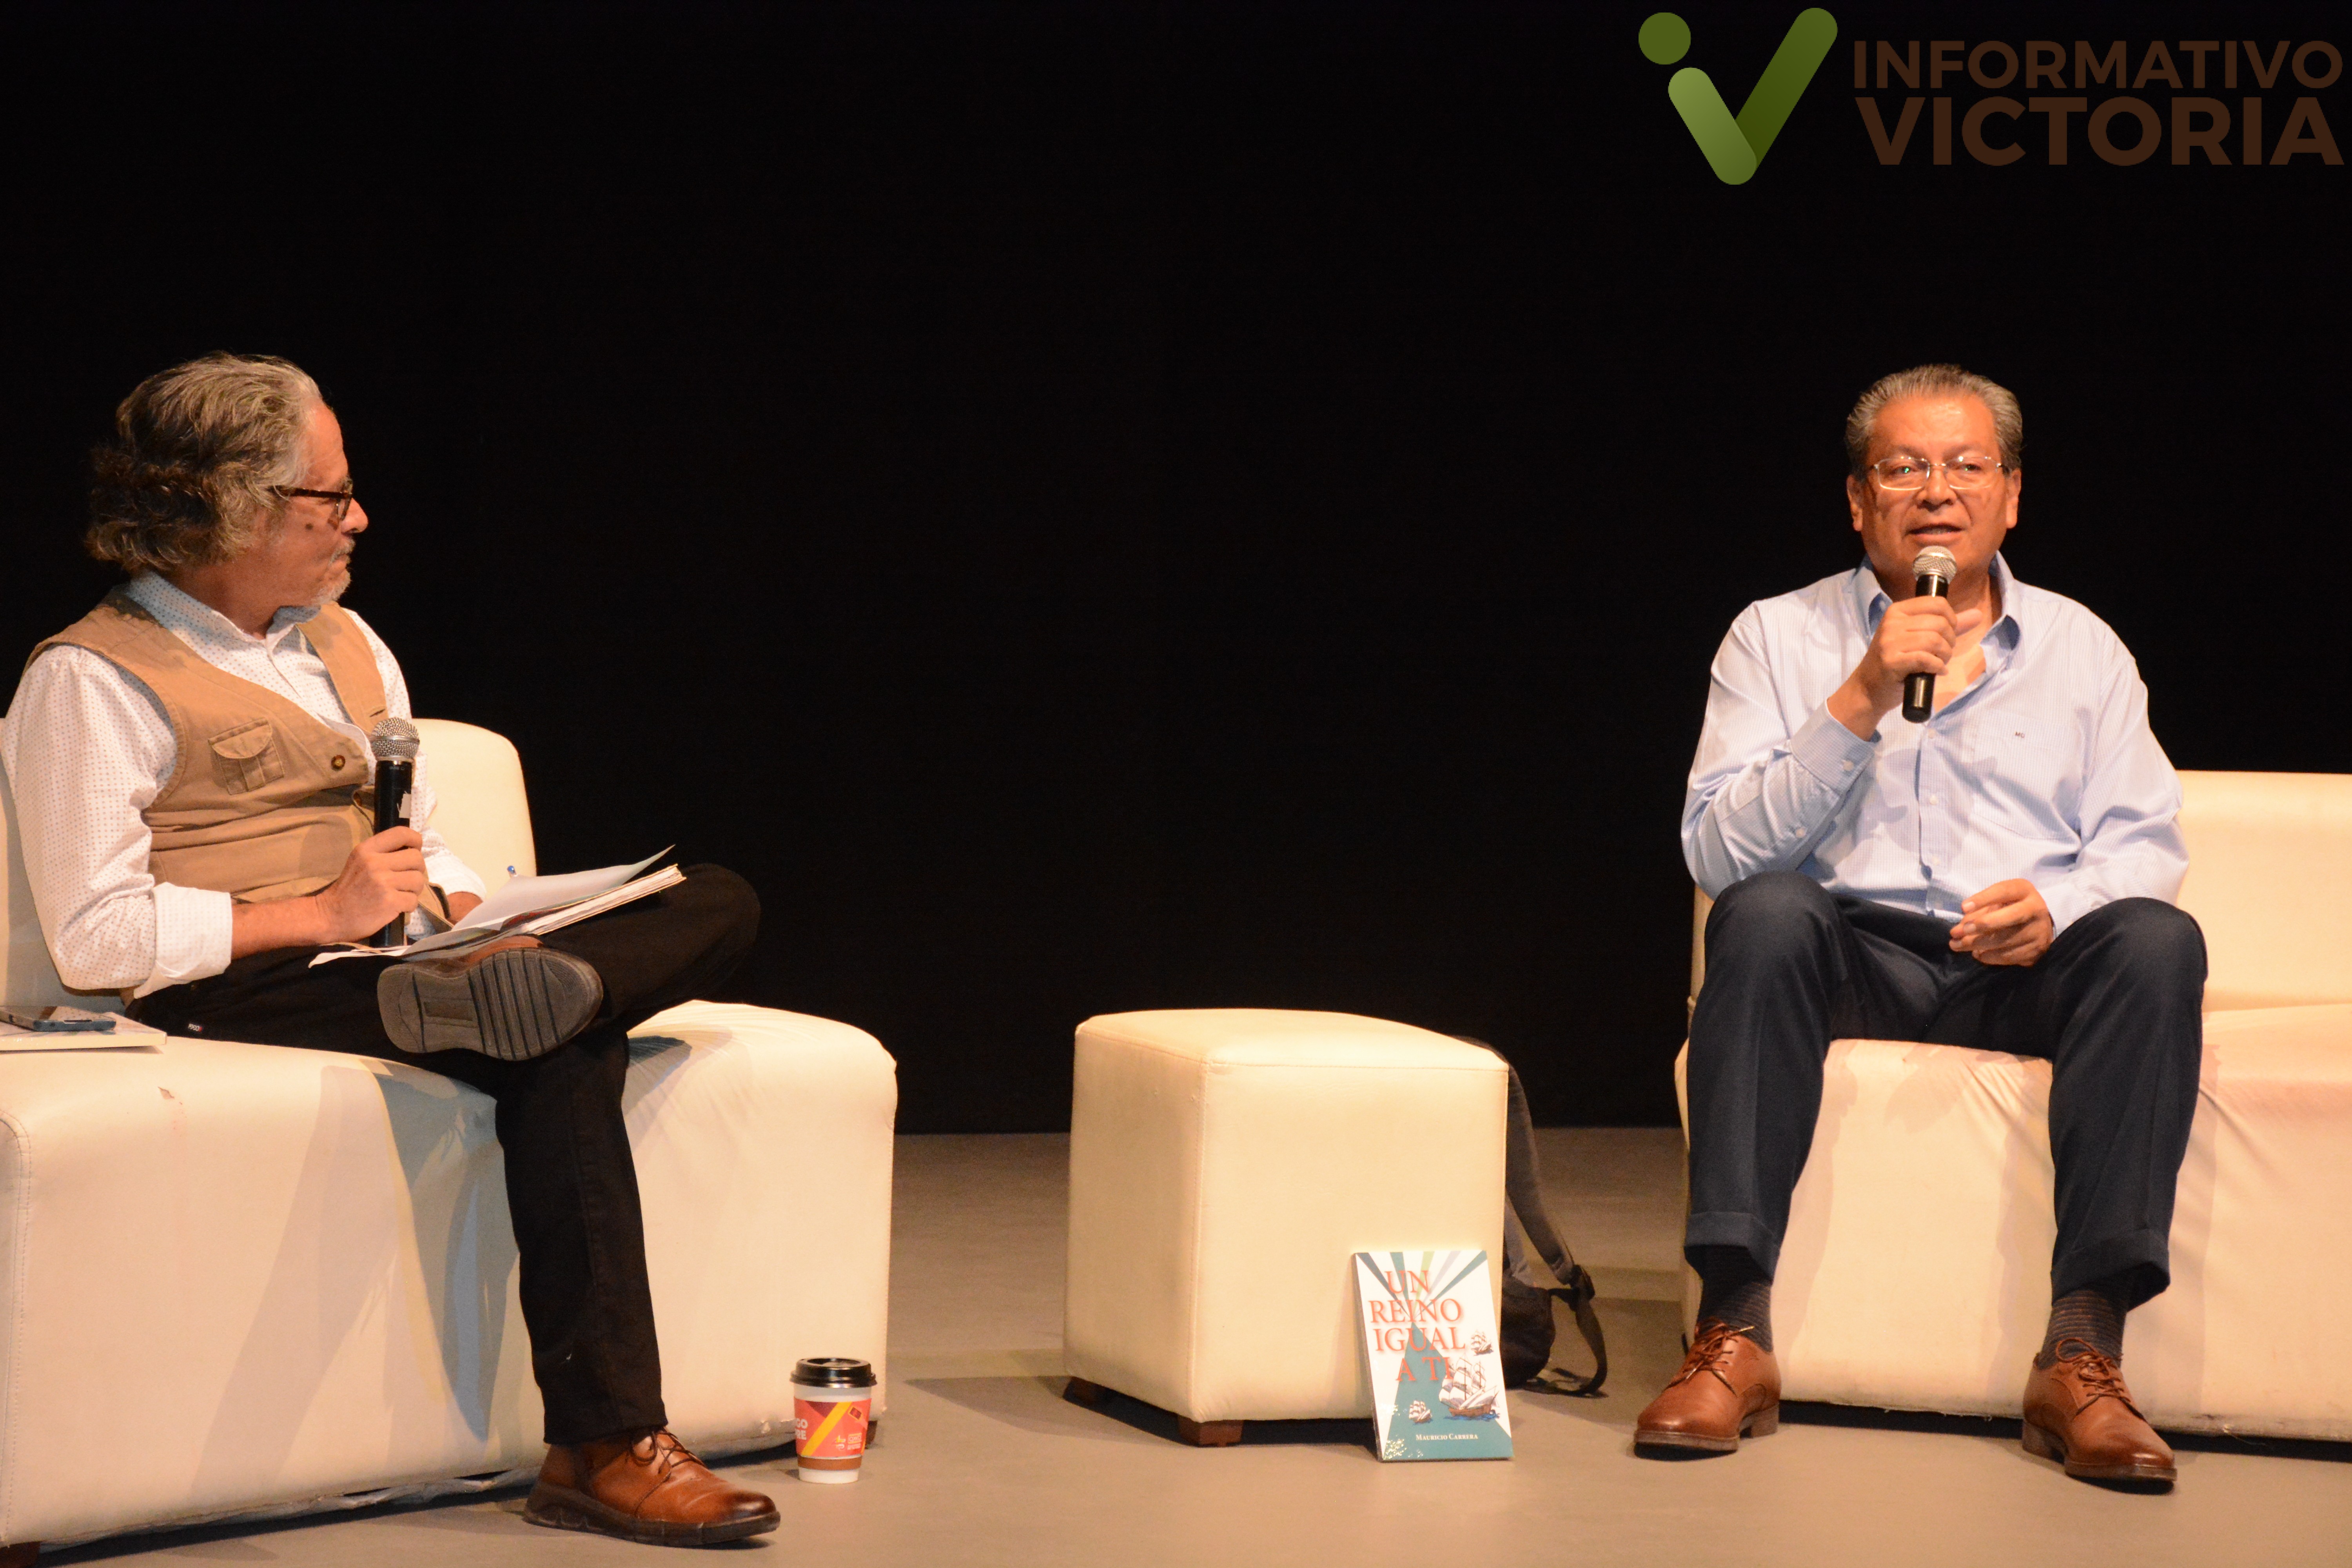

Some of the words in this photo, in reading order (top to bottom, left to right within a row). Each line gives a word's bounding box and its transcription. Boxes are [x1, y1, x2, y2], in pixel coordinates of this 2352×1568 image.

[1384, 1270, 1429, 1294] UN
[1368, 1299, 1461, 1323] REINO
[1373, 1327, 1466, 1352] IGUAL
[1395, 1357, 1416, 1381] A
[1421, 1356, 1454, 1381] TI
